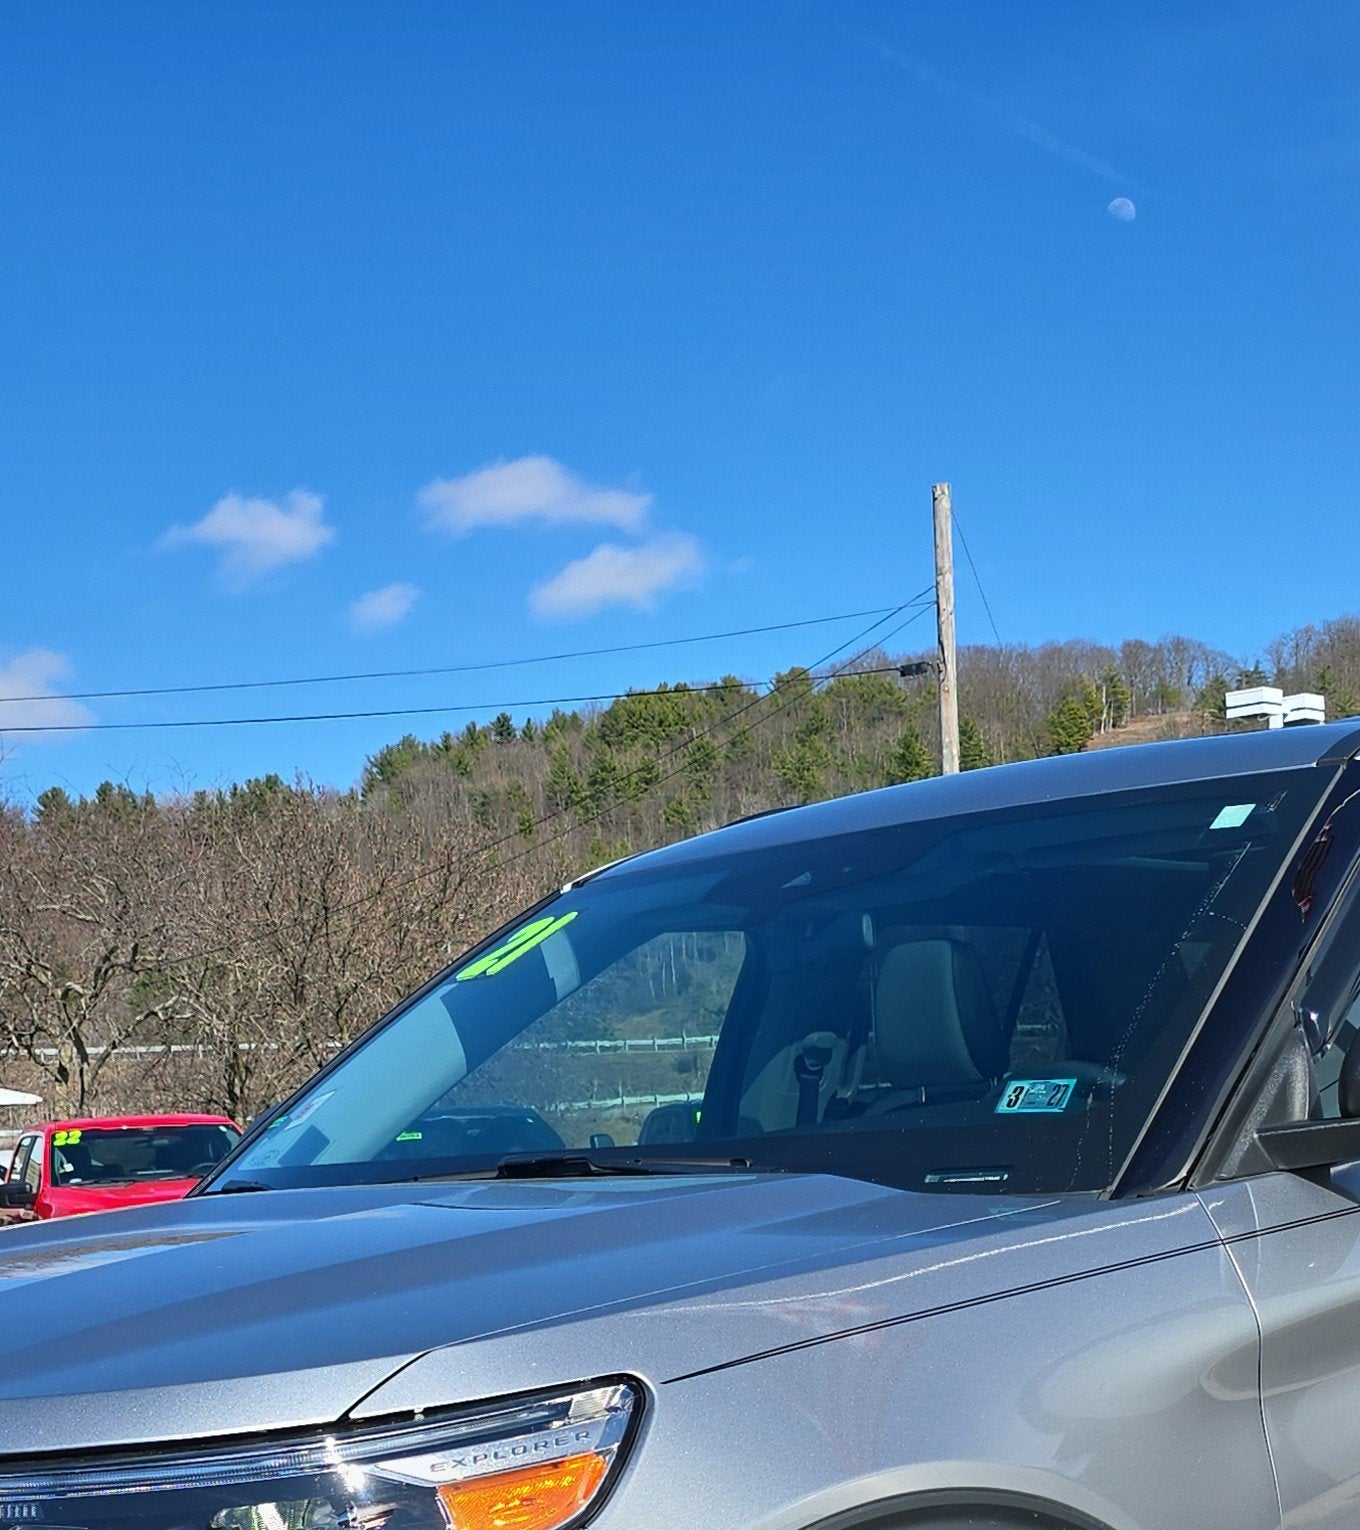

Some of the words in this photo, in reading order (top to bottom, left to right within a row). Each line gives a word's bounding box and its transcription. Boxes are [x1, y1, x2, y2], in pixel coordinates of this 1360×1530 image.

[1006, 1086, 1025, 1108] 3
[1046, 1083, 1070, 1107] 27
[53, 1130, 81, 1146] 22
[430, 1430, 590, 1473] EXPLORER
